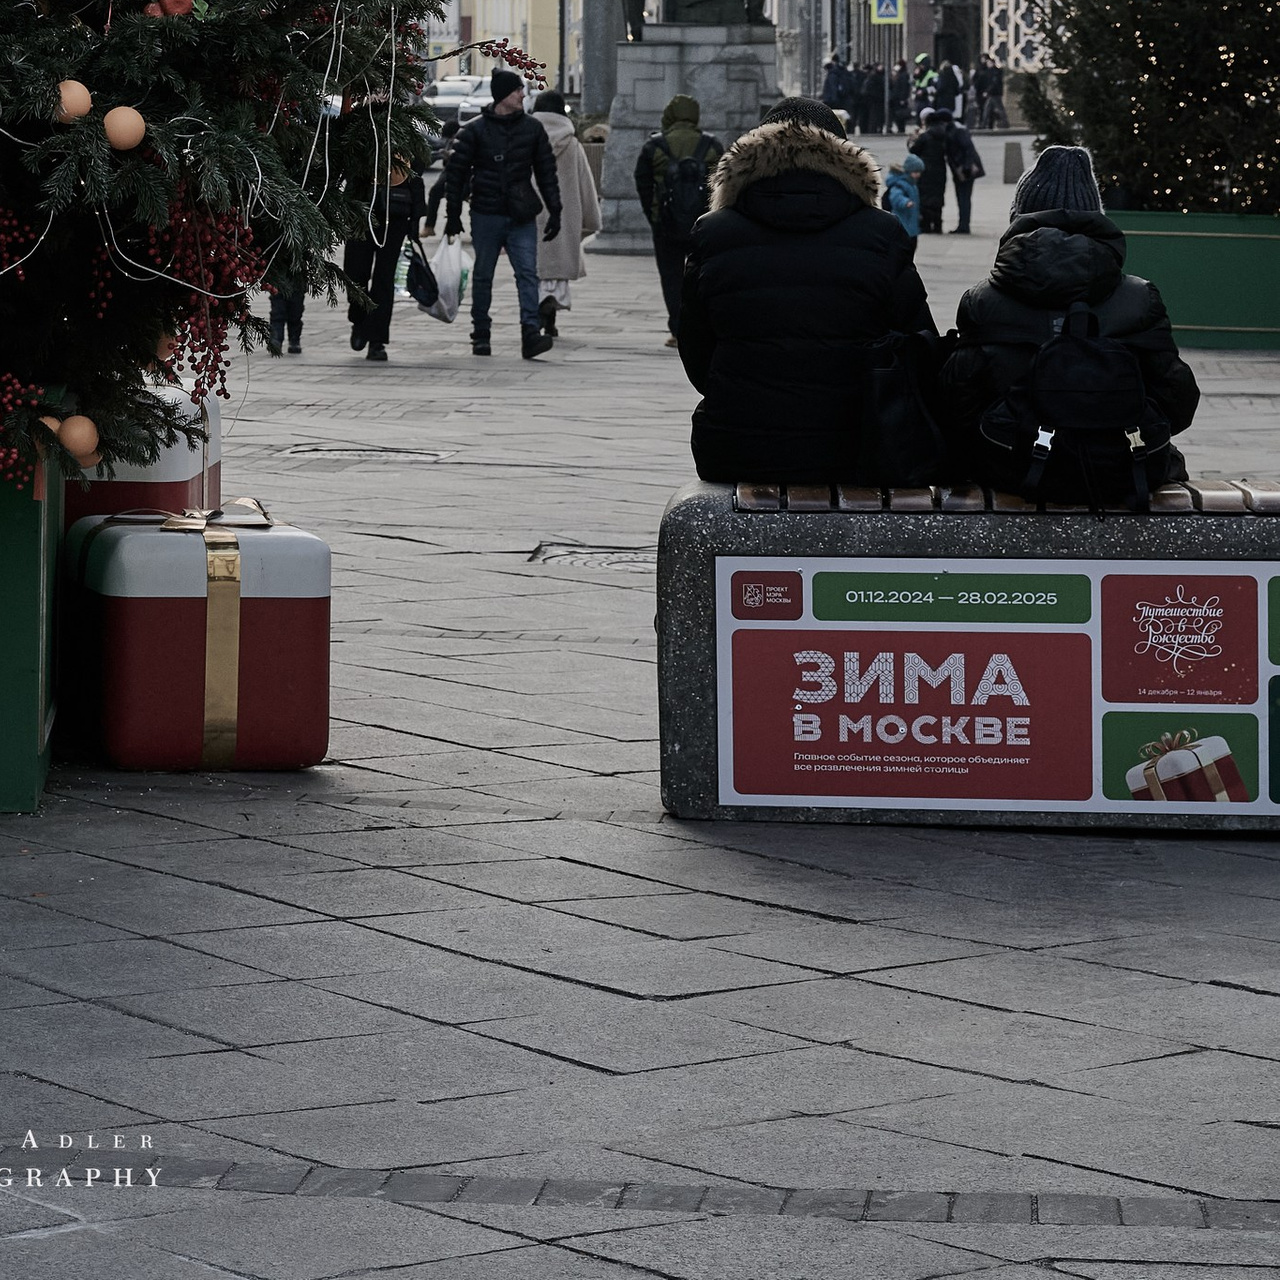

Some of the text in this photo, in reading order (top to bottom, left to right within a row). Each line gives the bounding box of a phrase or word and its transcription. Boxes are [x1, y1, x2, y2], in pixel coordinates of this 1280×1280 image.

[846, 591, 934, 604] 01.12.2024
[958, 591, 1057, 605] 28.02.2025
[1133, 601, 1224, 621] Путешествие
[792, 650, 1030, 706] ЗИМА
[1148, 689, 1178, 697] декабря
[793, 714, 1030, 745] В МОСКВЕ
[794, 752, 1030, 765] Главное событие сезона, которое объединяет
[814, 764, 881, 772] развлечения
[883, 765, 922, 773] зимней
[924, 766, 968, 774] столицы
